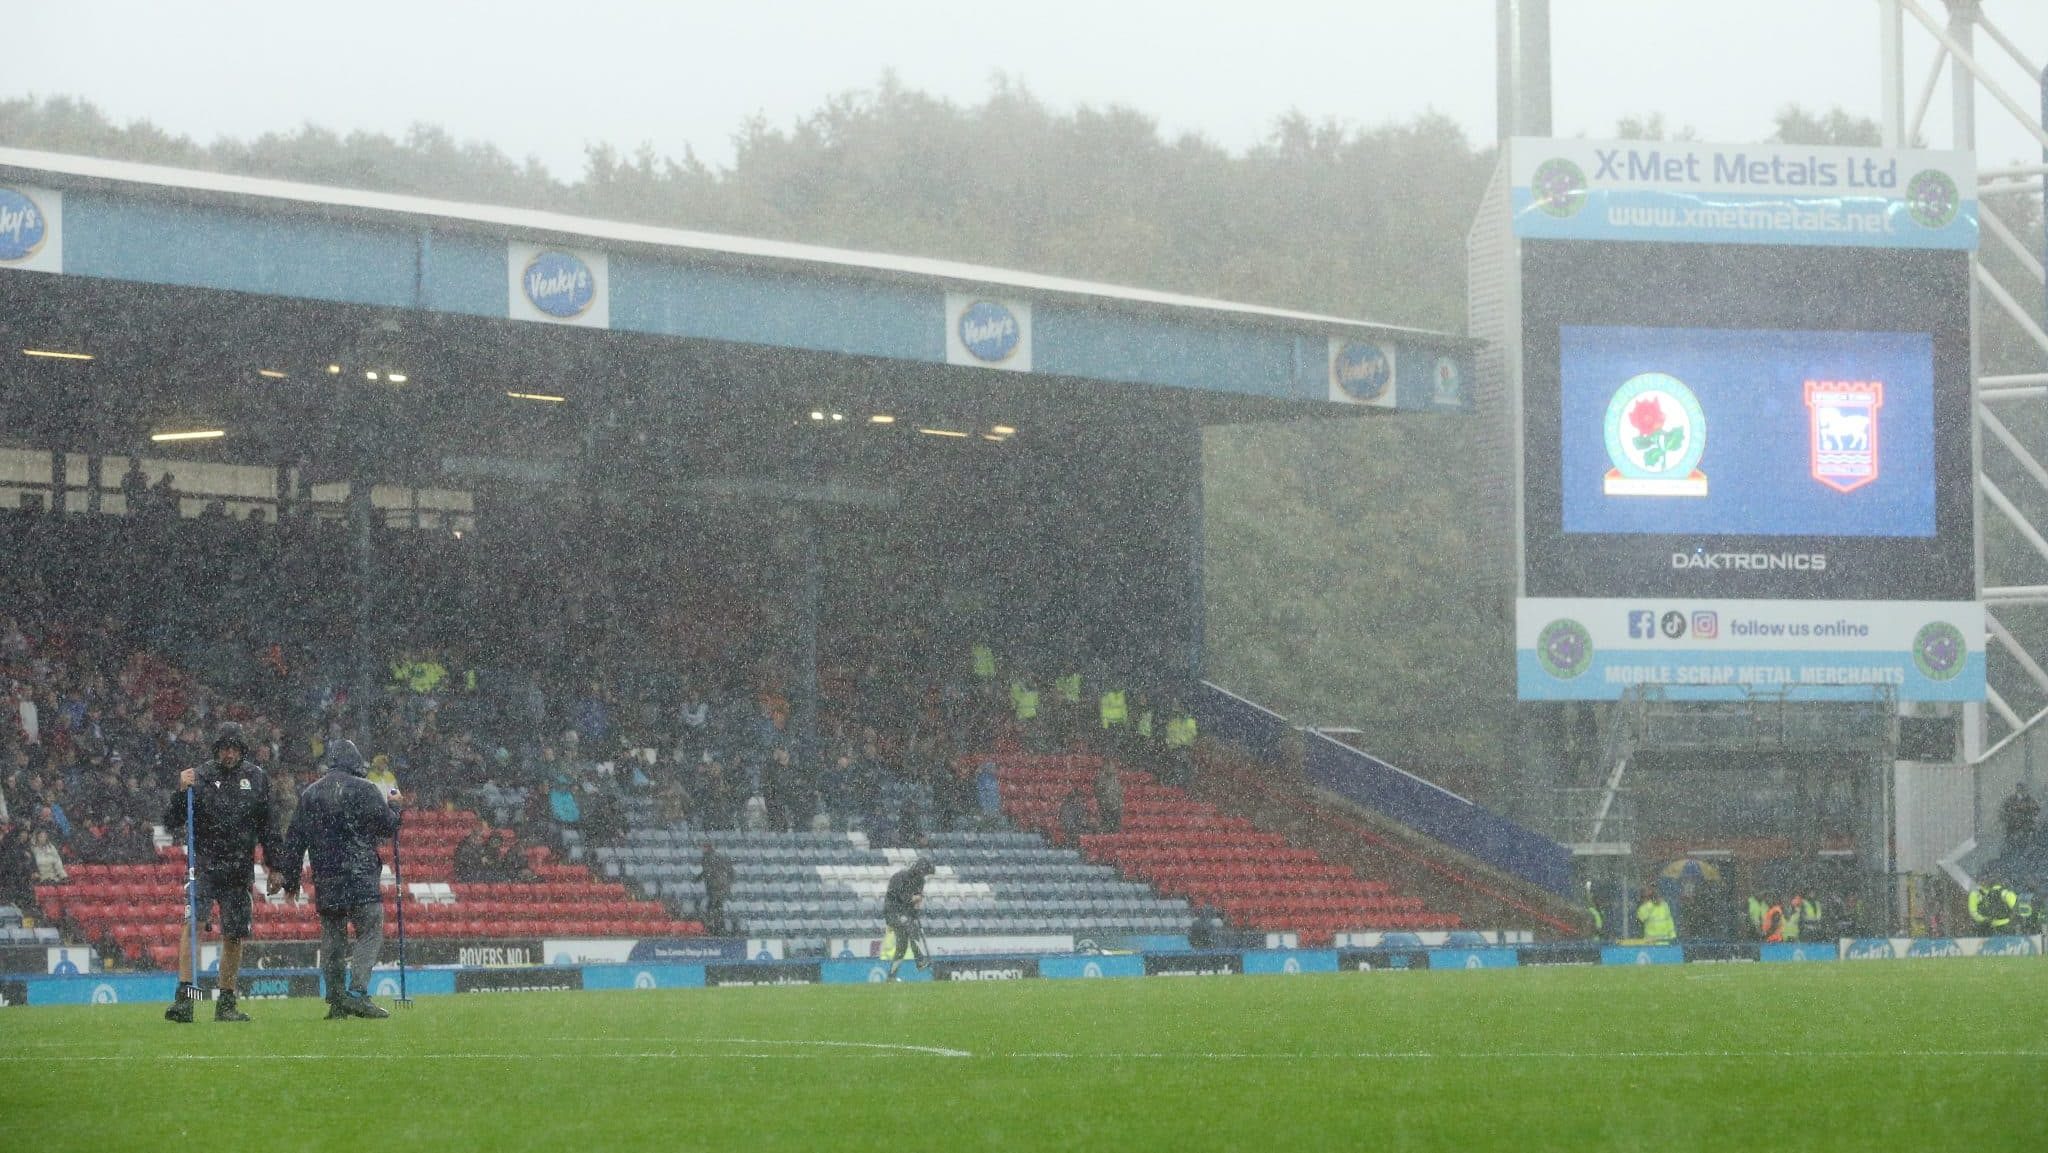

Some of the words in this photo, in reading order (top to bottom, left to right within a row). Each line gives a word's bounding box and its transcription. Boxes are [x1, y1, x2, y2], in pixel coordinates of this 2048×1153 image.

[1594, 149, 1701, 183] X-Met
[1713, 152, 1838, 187] Metals
[1847, 156, 1897, 188] Ltd
[1607, 204, 1894, 233] www.xmetmetals.net
[530, 266, 587, 303] Venky's
[1671, 552, 1827, 571] DAKTRONICS
[1730, 619, 1785, 637] follow
[1788, 624, 1810, 637] us
[1813, 620, 1870, 638] online
[1605, 665, 1672, 685] MOBILE
[1677, 665, 1734, 686] SCRAP
[1738, 666, 1792, 686] METAL
[1800, 666, 1905, 687] MERCHANTS
[459, 947, 505, 967] ROVERS
